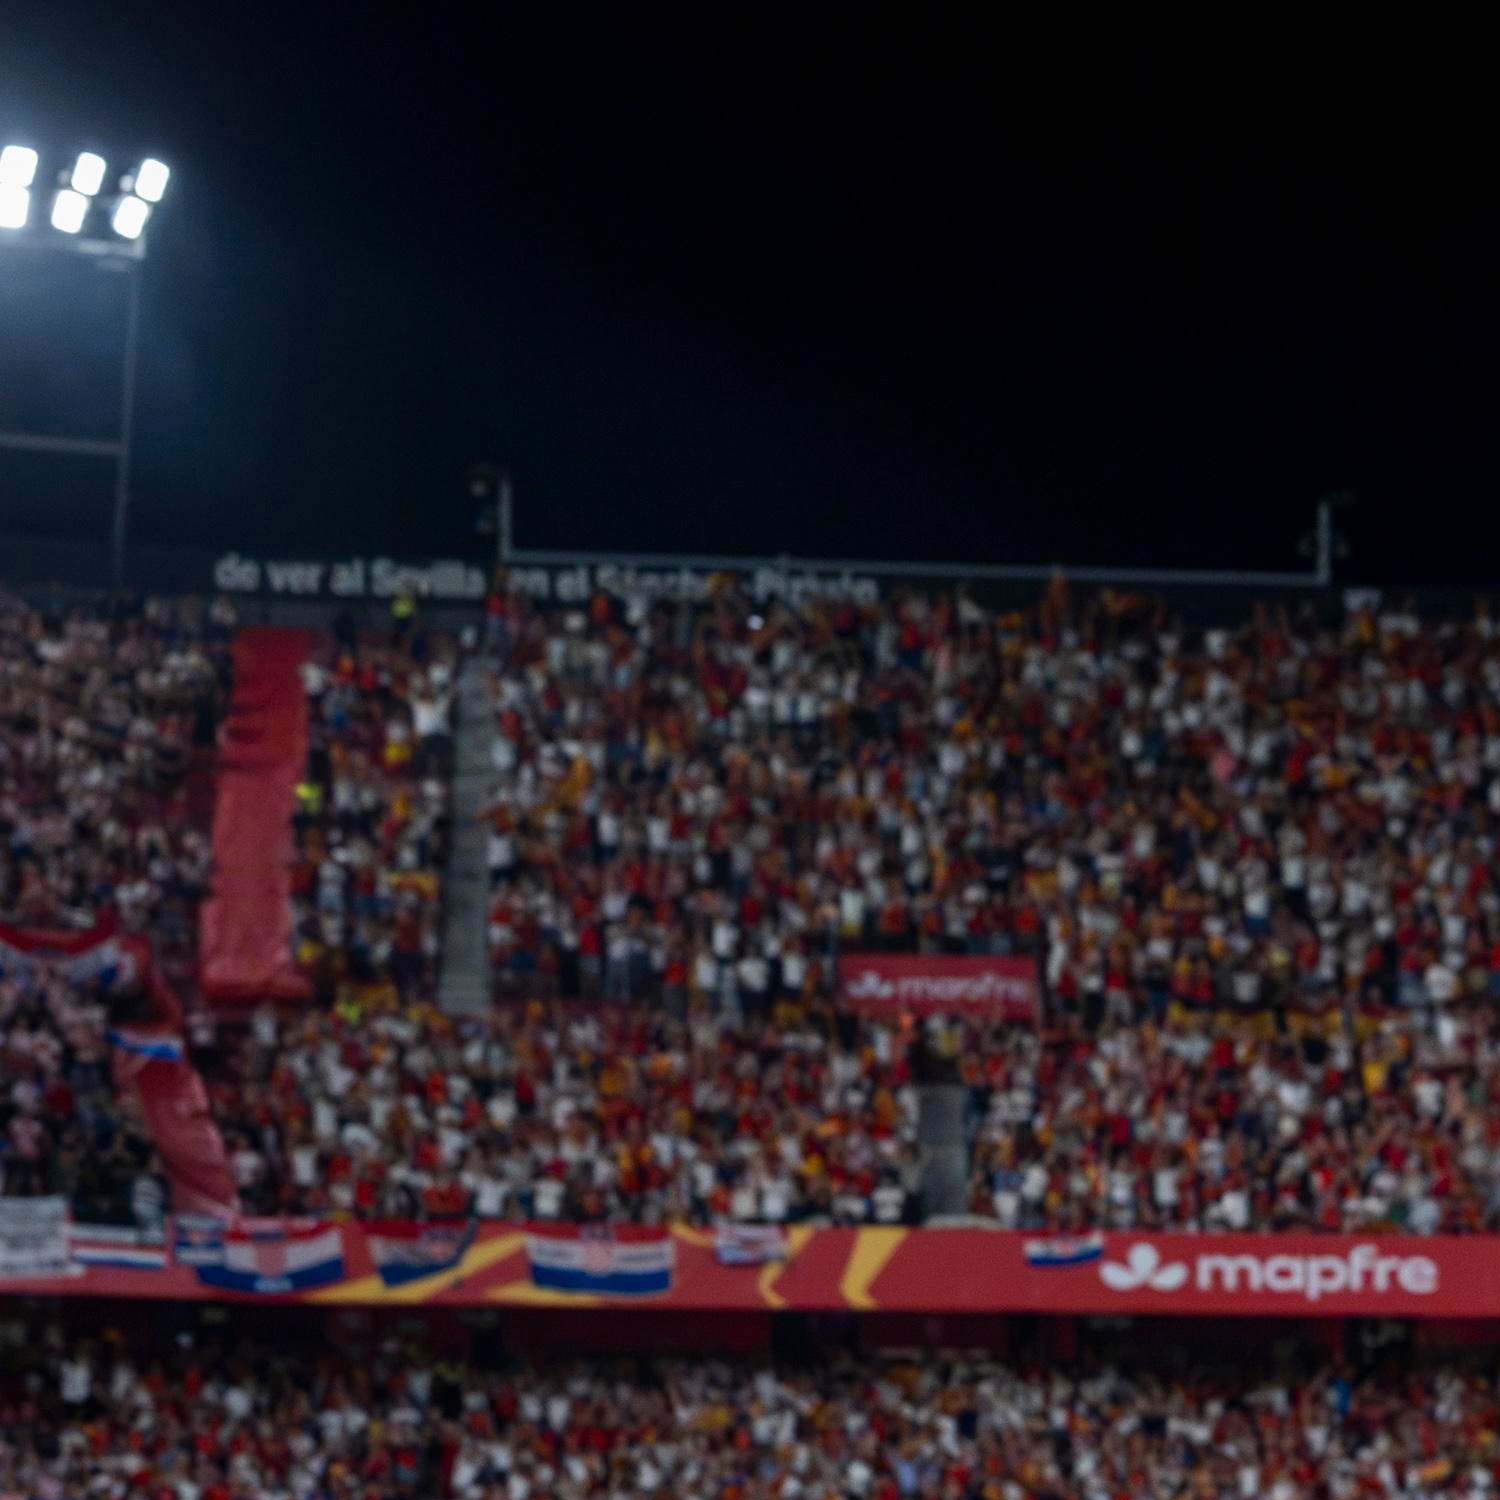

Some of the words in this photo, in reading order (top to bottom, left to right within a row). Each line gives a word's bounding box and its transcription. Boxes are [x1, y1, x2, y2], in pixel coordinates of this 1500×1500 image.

[266, 562, 321, 593] ver
[329, 557, 364, 595] al
[1197, 1243, 1439, 1300] mapfre
